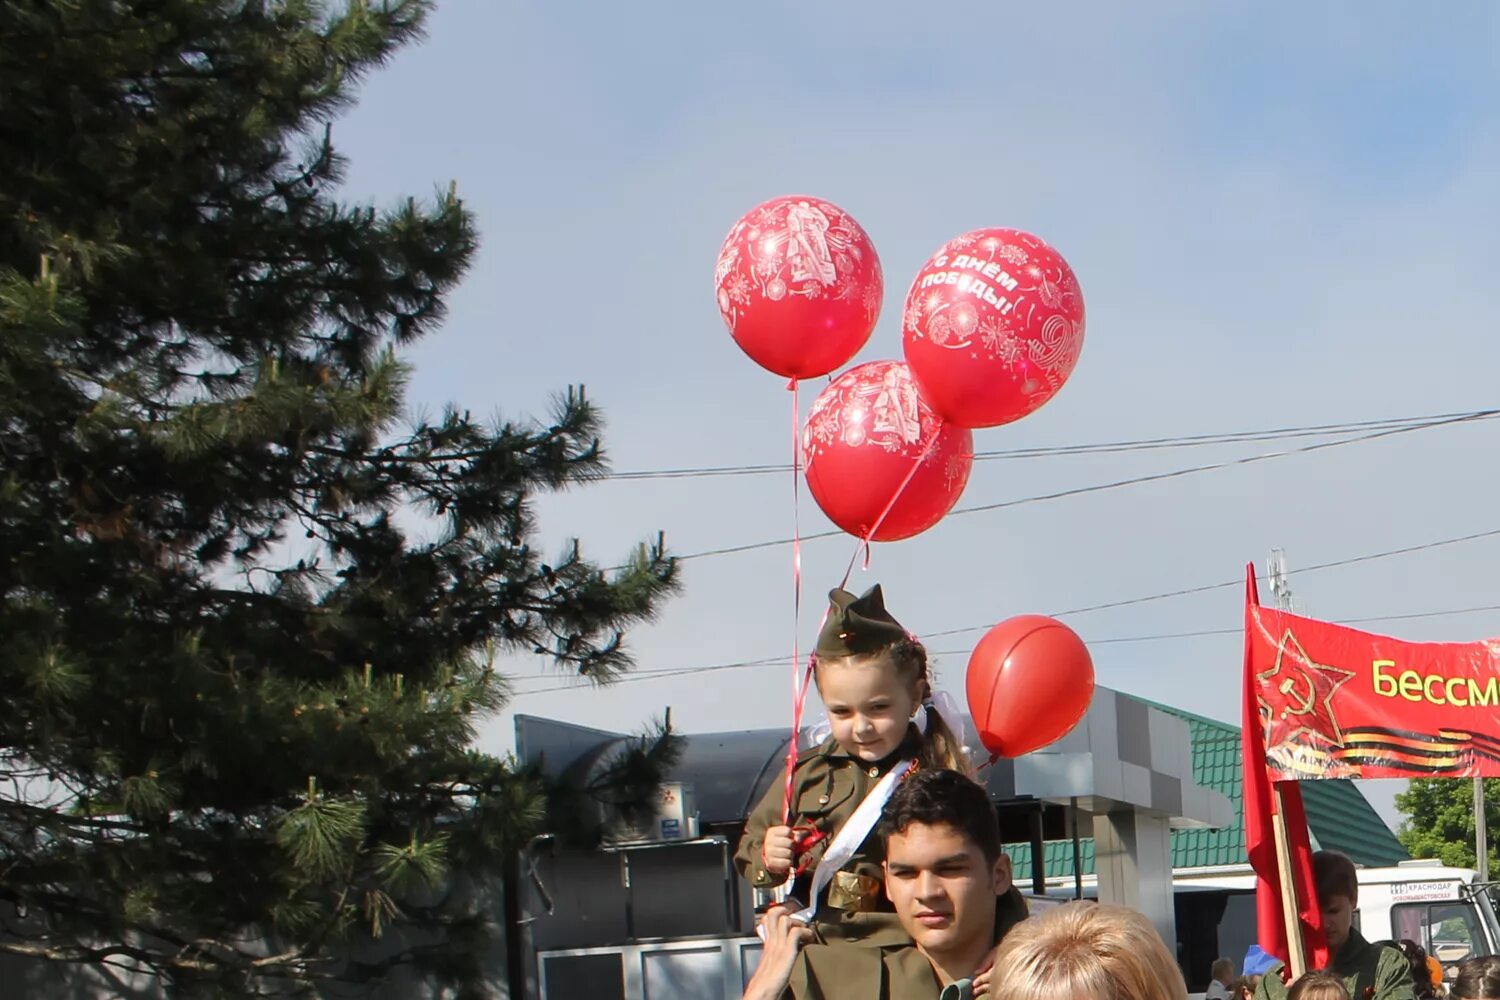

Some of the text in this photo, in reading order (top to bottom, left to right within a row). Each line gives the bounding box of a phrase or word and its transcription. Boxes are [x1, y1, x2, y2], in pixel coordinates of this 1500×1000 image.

[934, 255, 1017, 291] С ДНЁМ
[1409, 882, 1452, 891] КРАСНОДАР
